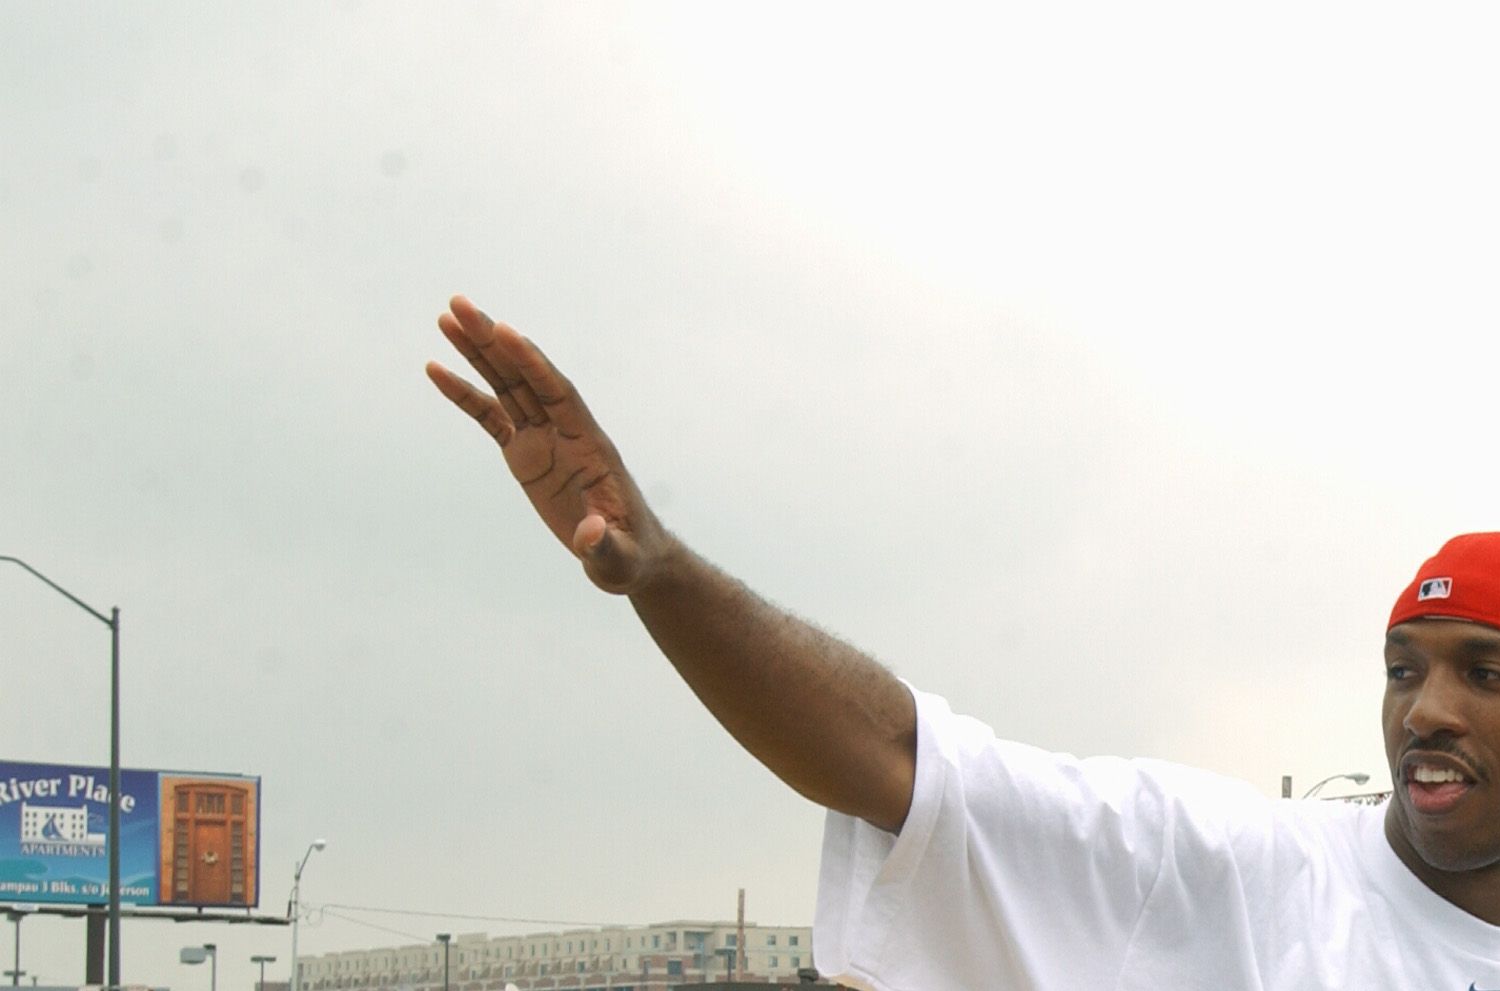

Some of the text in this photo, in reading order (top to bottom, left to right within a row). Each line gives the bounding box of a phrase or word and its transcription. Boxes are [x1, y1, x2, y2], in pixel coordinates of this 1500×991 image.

[68, 773, 137, 813] Plae
[21, 842, 106, 857] APARTMENTS
[0, 880, 39, 895] ampau
[100, 882, 150, 898] Jeerson
